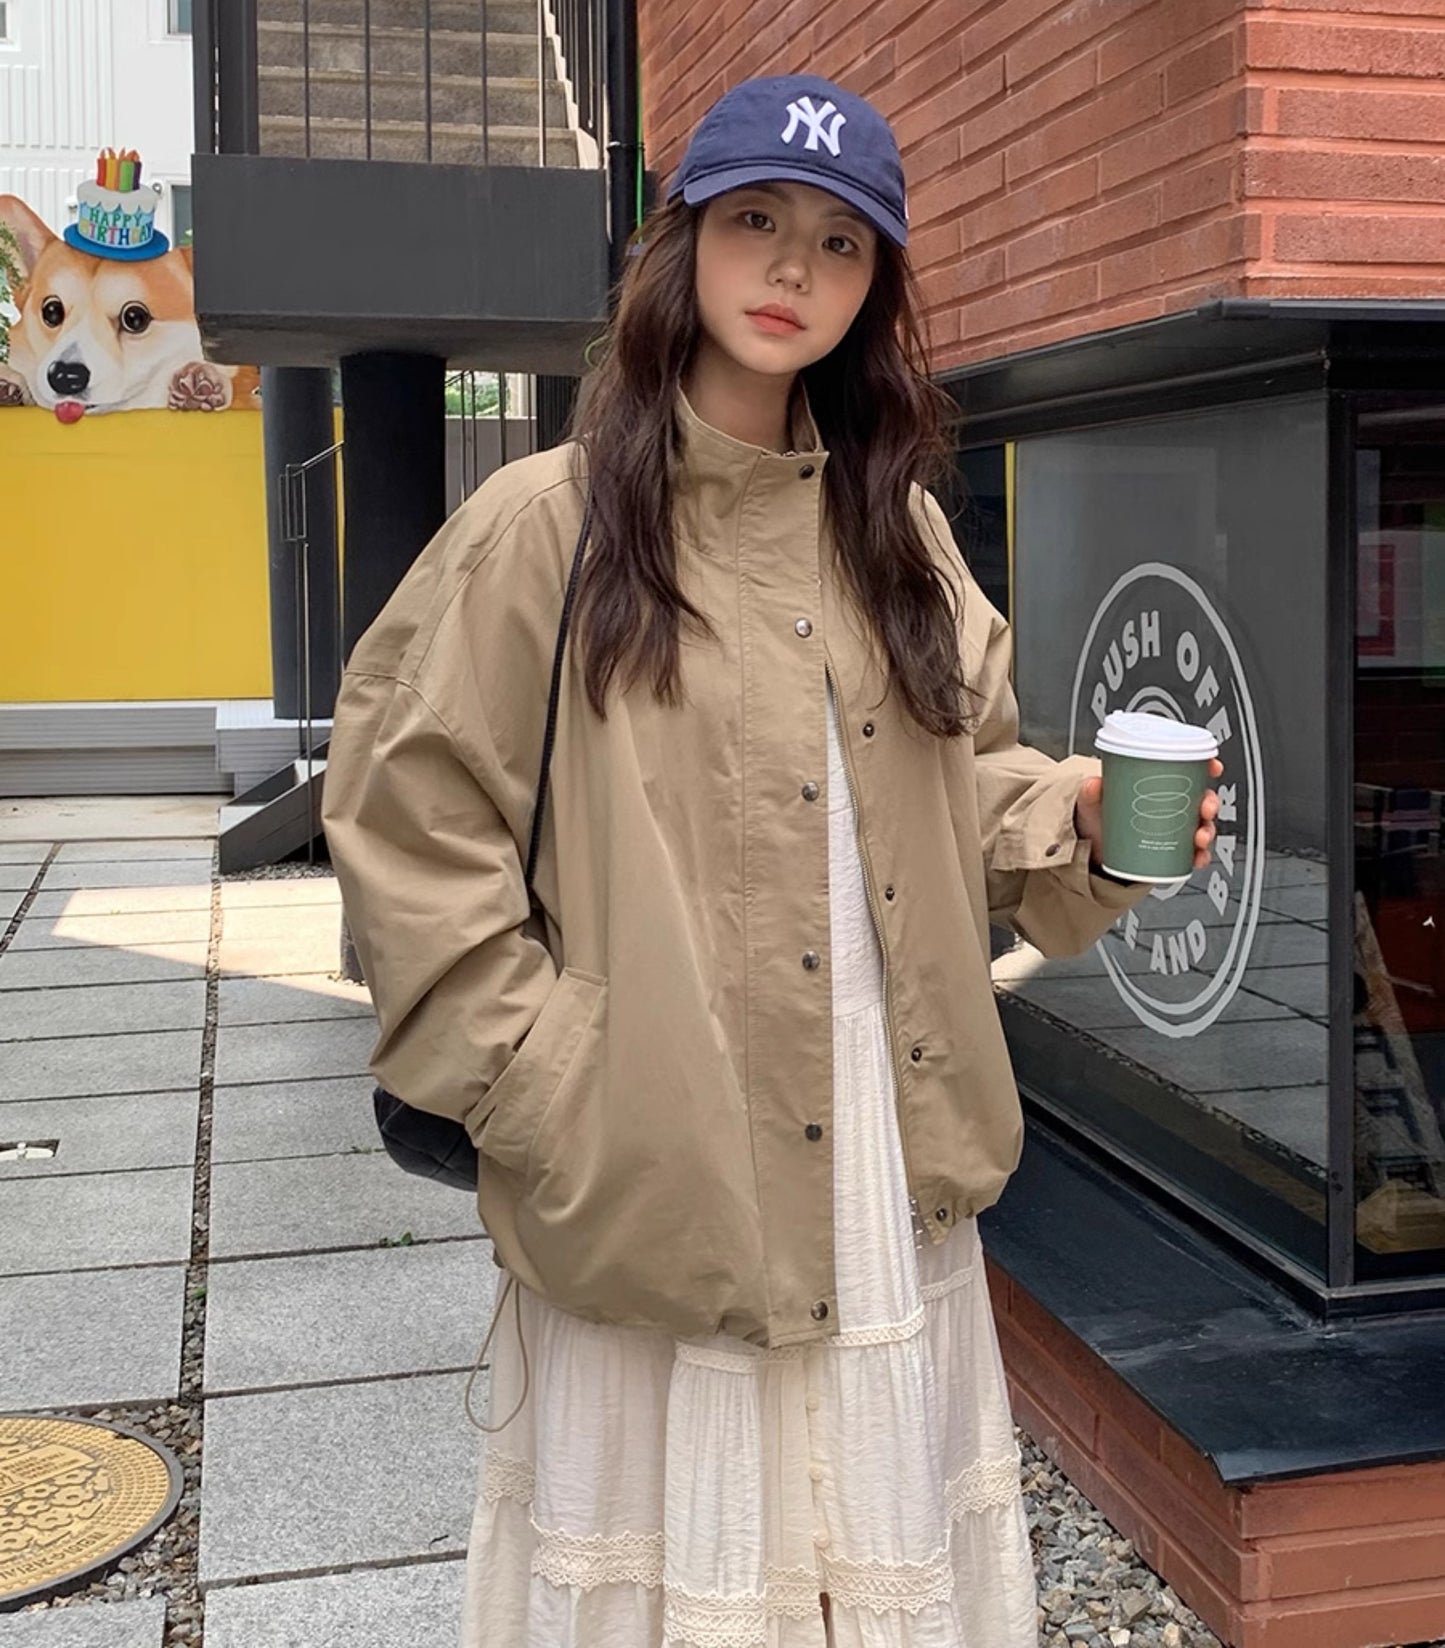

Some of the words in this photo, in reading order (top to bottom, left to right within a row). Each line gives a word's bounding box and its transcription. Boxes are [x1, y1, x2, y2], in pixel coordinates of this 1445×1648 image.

[781, 96, 846, 157] NY
[89, 208, 142, 227] HAPPY
[1091, 610, 1161, 727] PUSH
[1150, 919, 1206, 976] AND
[1207, 783, 1237, 916] BAR
